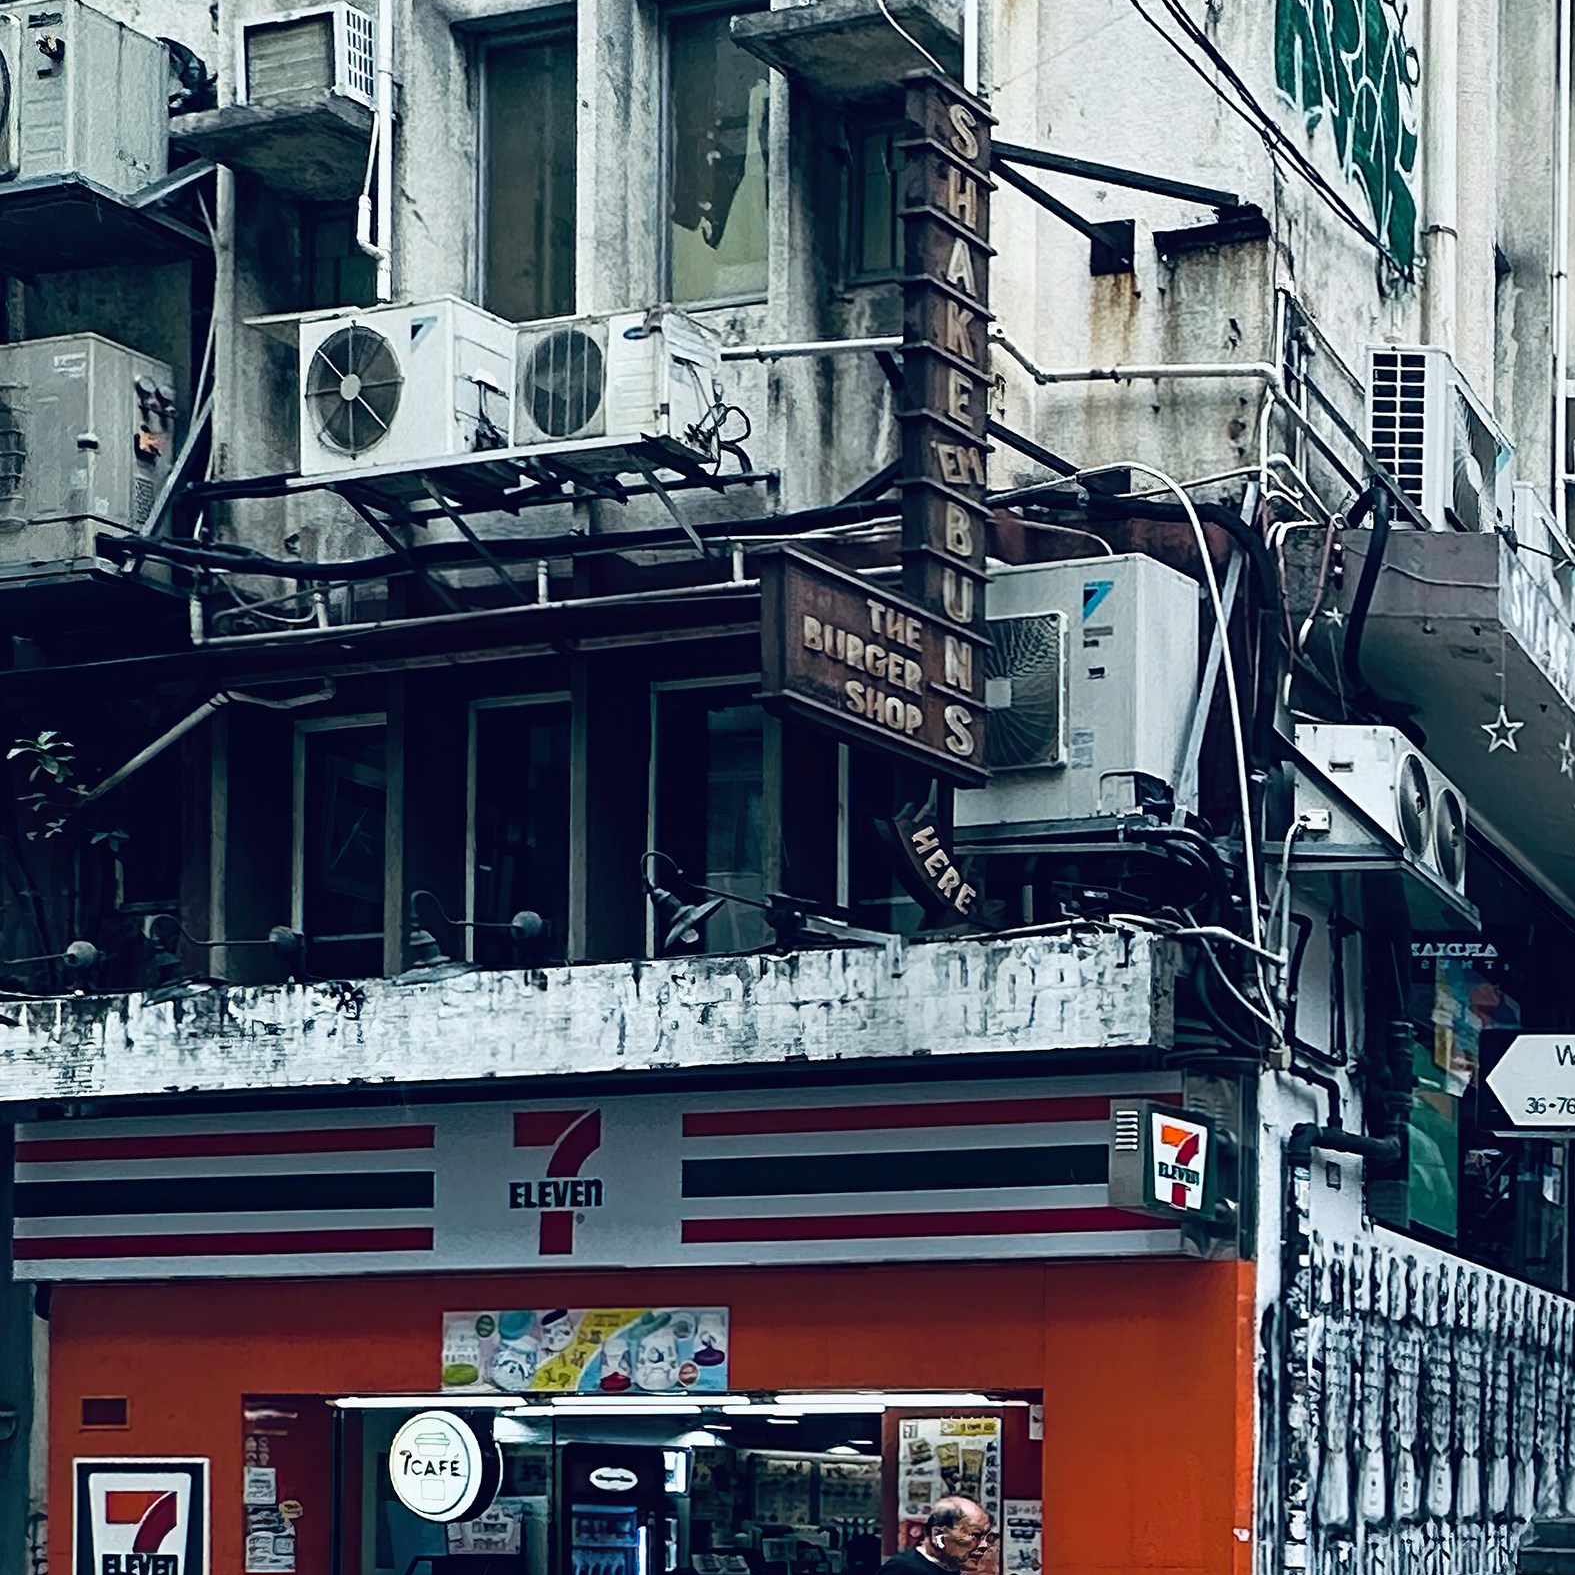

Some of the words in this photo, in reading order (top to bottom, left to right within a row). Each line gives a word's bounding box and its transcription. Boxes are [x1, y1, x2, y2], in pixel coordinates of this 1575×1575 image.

[945, 103, 979, 426] SHAKE
[803, 615, 923, 696] BURGER
[866, 598, 923, 654] THE
[943, 500, 975, 758] BUNS
[846, 680, 923, 736] SHOP
[911, 825, 977, 915] HERE
